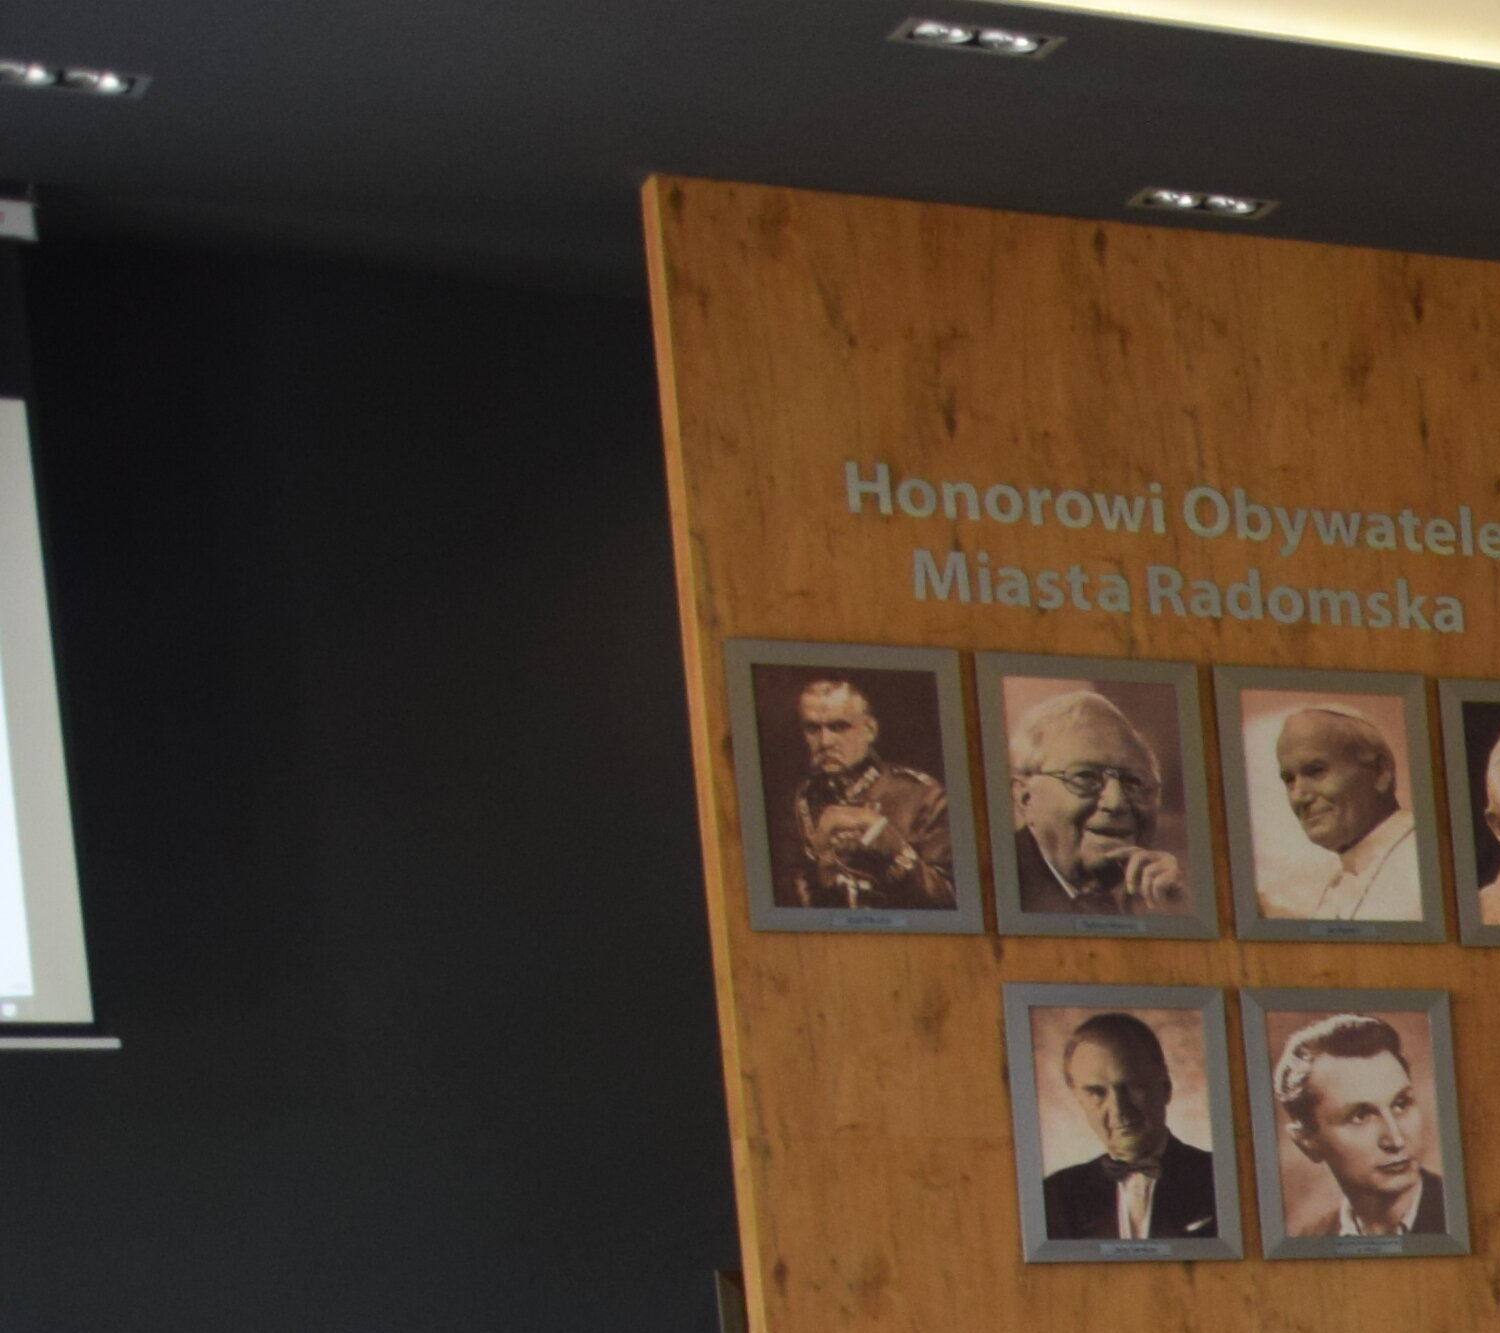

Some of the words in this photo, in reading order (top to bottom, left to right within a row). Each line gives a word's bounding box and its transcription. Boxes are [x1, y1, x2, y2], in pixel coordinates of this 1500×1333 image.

[843, 459, 1167, 535] Honorowi
[911, 548, 1132, 614] Miasta
[1145, 564, 1466, 634] Radomska
